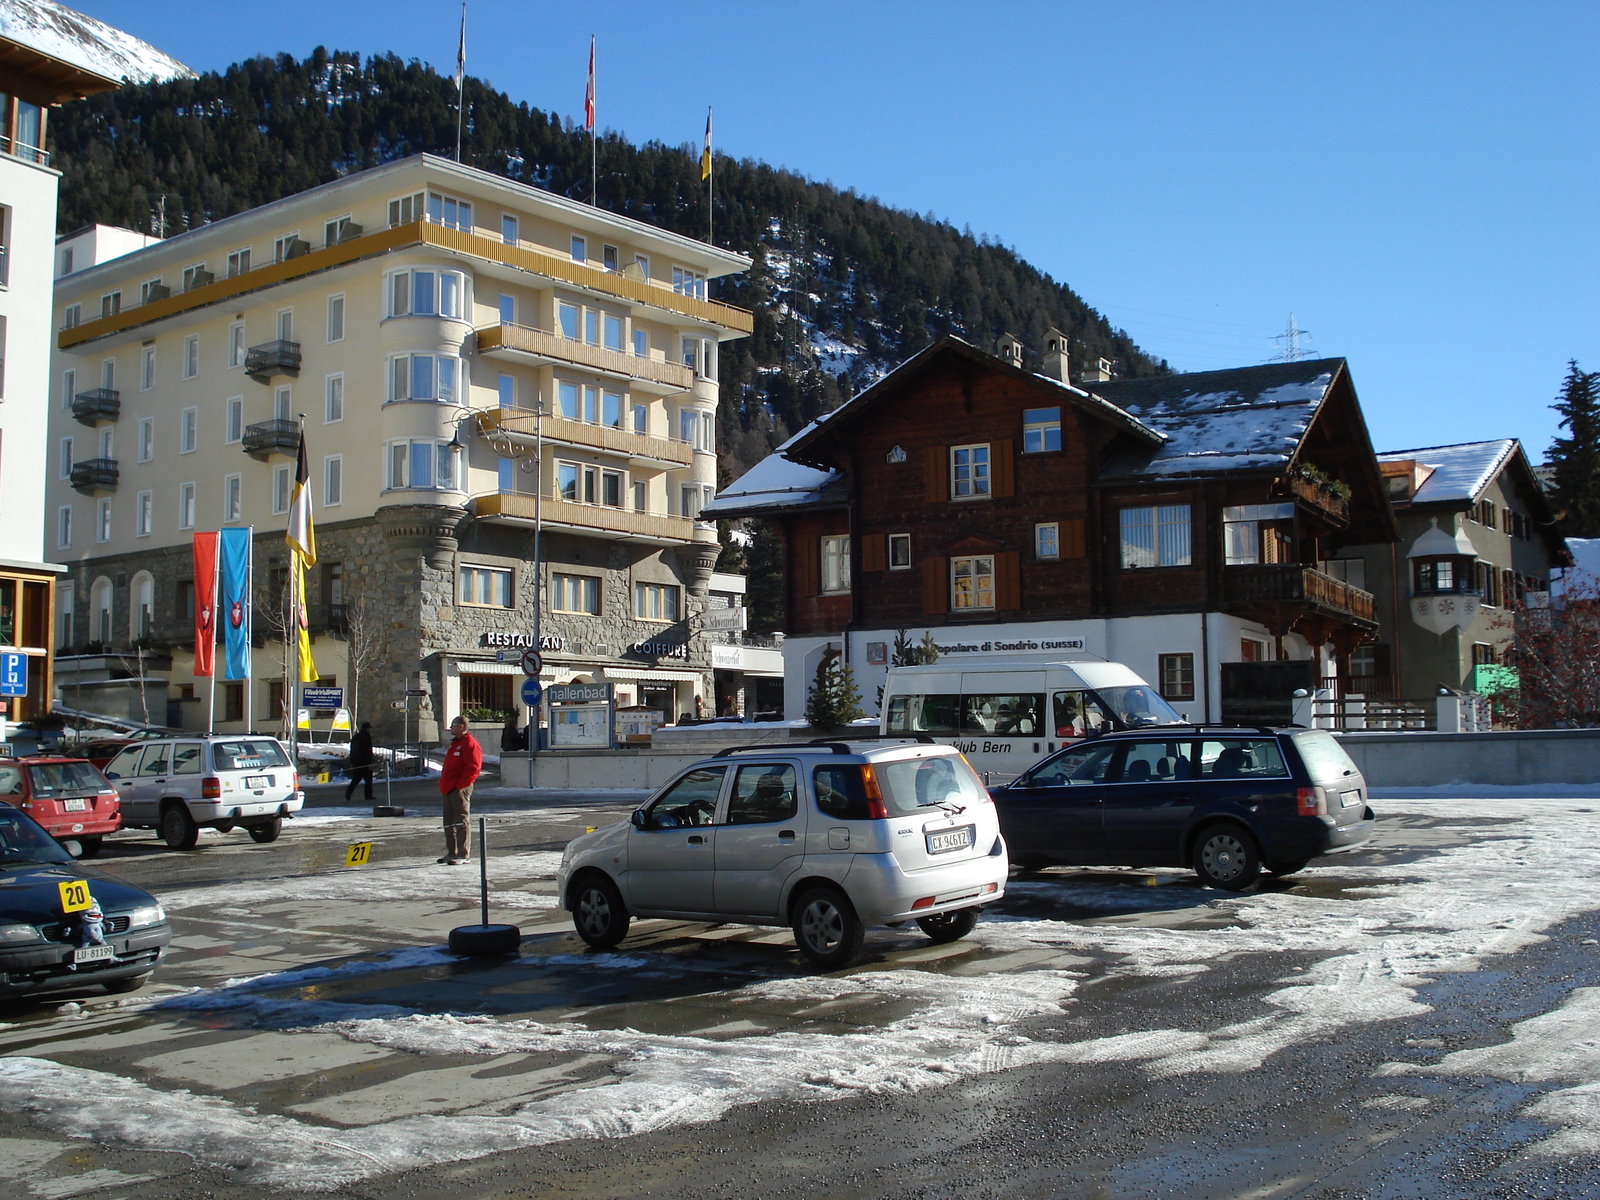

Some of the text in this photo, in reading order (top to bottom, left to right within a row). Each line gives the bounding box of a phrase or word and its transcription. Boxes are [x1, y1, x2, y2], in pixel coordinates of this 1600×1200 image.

[487, 632, 565, 650] RESTAUANT
[981, 641, 991, 651] di
[994, 640, 1038, 651] Sondrio
[1040, 639, 1083, 650] (SUISSE)
[633, 642, 687, 657] COIFFURE
[9, 655, 18, 672] P
[550, 686, 607, 700] hallenbad
[983, 741, 1011, 753] Bern
[932, 836, 943, 850] CX
[351, 846, 366, 862] 21
[65, 885, 86, 906] 20
